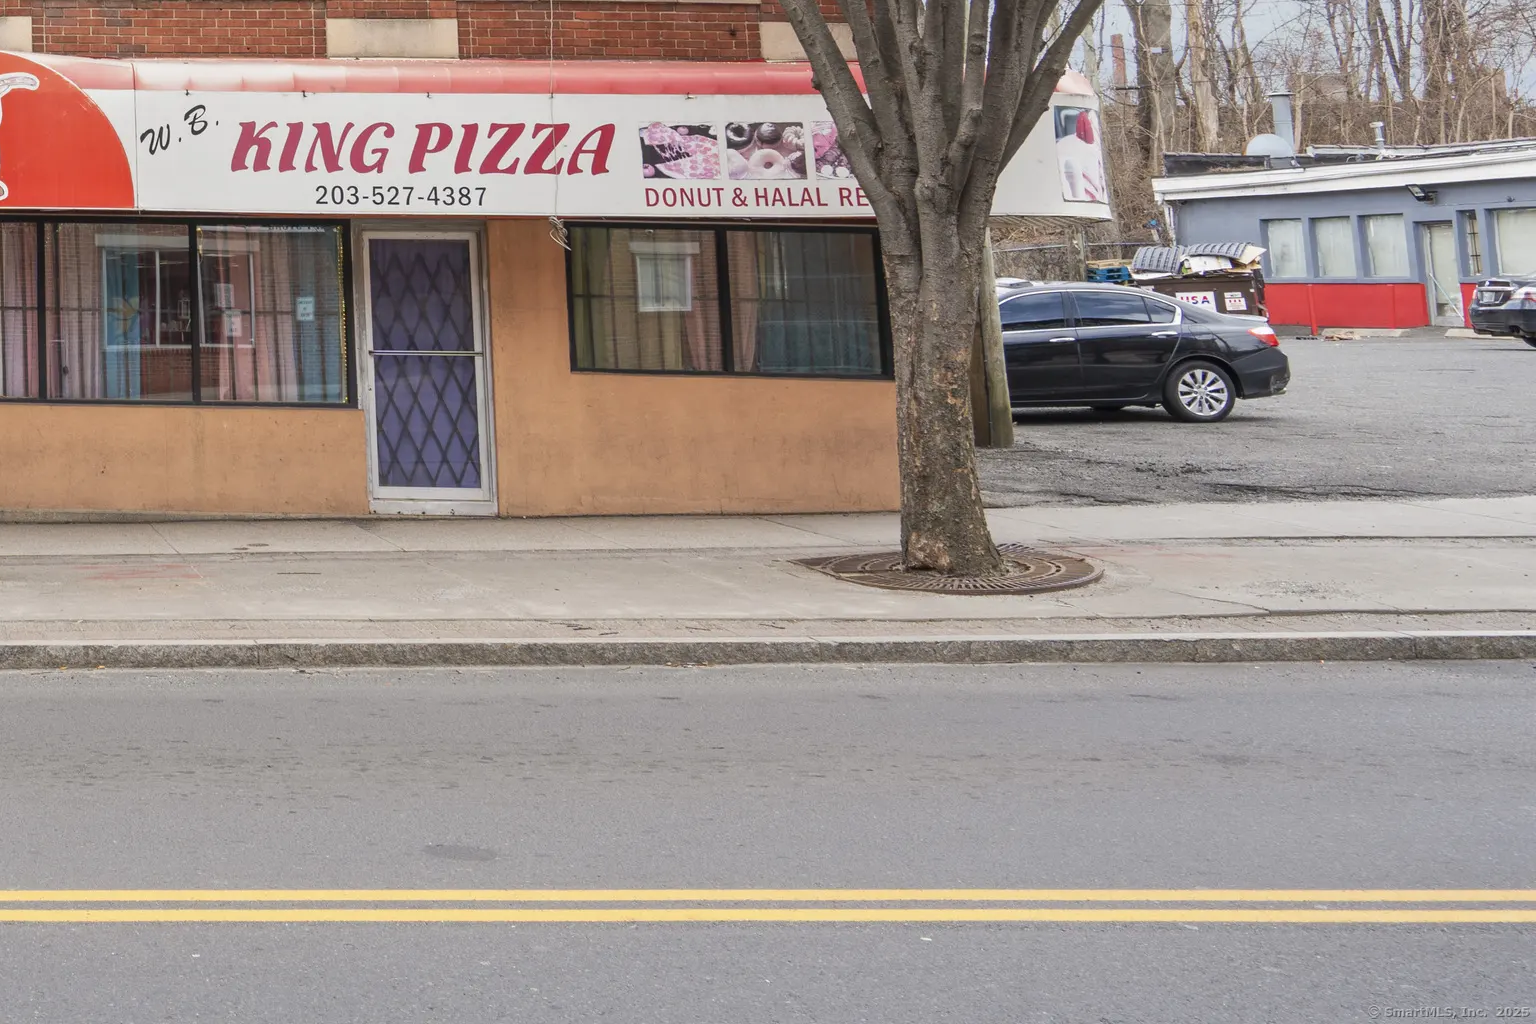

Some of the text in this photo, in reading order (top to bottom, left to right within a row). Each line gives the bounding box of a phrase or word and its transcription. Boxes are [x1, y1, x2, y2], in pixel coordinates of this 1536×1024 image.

[230, 121, 616, 176] KING PIZZA
[314, 185, 488, 207] 203-527-4387
[644, 187, 725, 208] DONUT
[731, 187, 749, 208] &
[754, 187, 828, 208] HALAL
